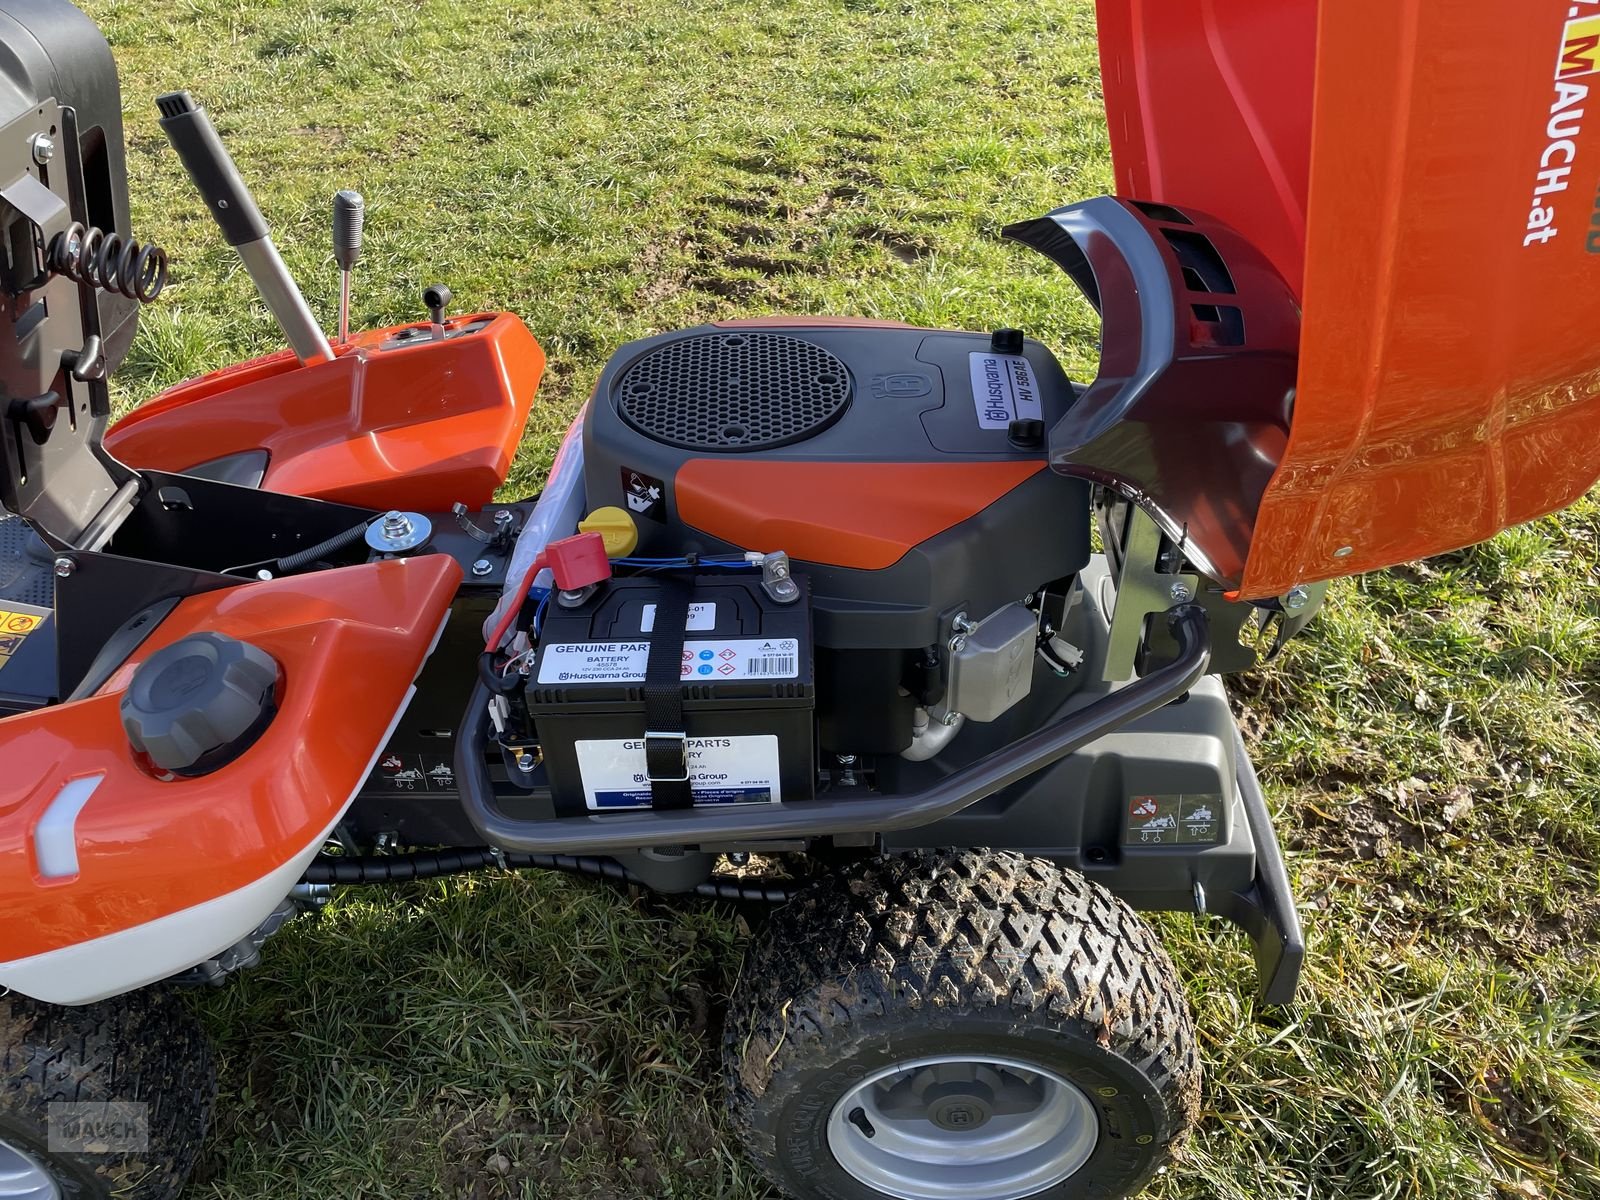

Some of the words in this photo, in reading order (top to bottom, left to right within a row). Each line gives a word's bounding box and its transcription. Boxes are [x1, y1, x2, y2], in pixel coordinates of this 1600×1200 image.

[984, 359, 1004, 410] Husqvarna
[1018, 388, 1034, 402] HV
[555, 645, 617, 653] GENUINE
[569, 672, 620, 680] Husqvarna
[687, 739, 731, 748] PARTS
[698, 773, 728, 781] Group
